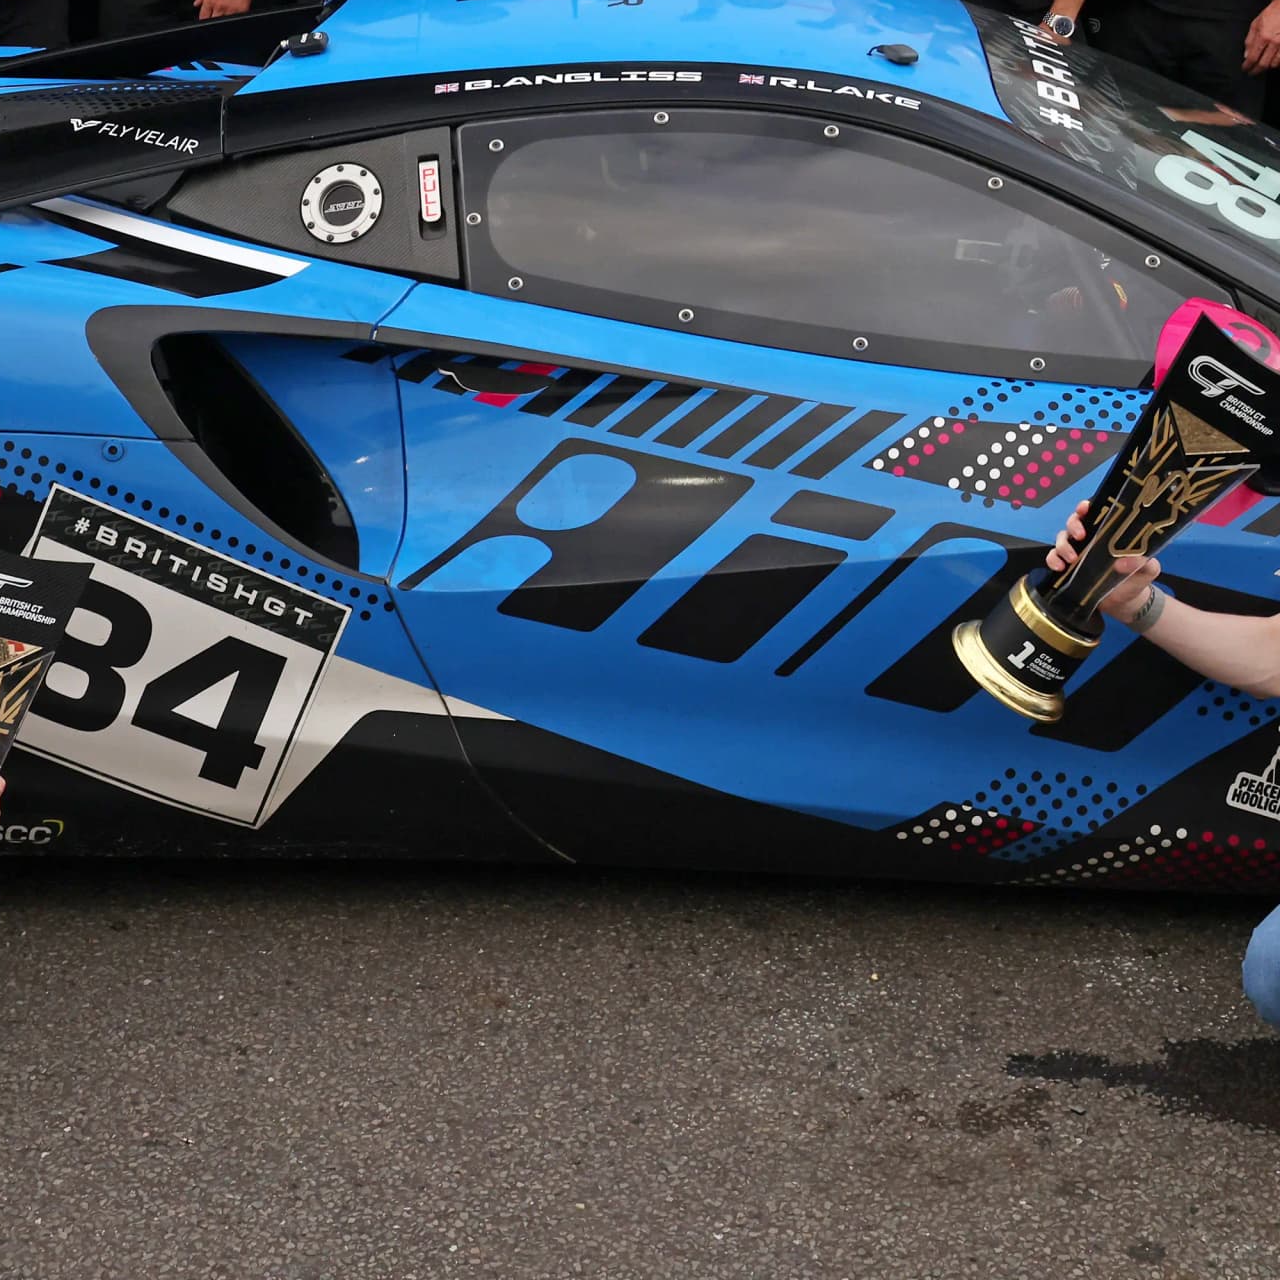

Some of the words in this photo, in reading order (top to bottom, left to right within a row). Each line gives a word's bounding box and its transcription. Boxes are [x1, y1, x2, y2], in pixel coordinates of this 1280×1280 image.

[465, 71, 703, 92] B.ANGLISS
[769, 76, 922, 111] R.LAKE
[98, 122, 135, 139] FLY
[134, 128, 200, 155] VELAIR
[422, 167, 439, 218] PULL
[1219, 400, 1274, 436] CHAMPIONSHIP
[1225, 394, 1257, 416] BRITISH
[1253, 412, 1266, 423] GT
[73, 515, 314, 628] #BRITISHGT
[0, 596, 31, 611] BRITISH
[30, 603, 44, 614] GT
[1007, 641, 1036, 669] 1
[1034, 657, 1061, 675] OVERALL
[1039, 653, 1053, 664] GT4
[28, 573, 288, 790] 84
